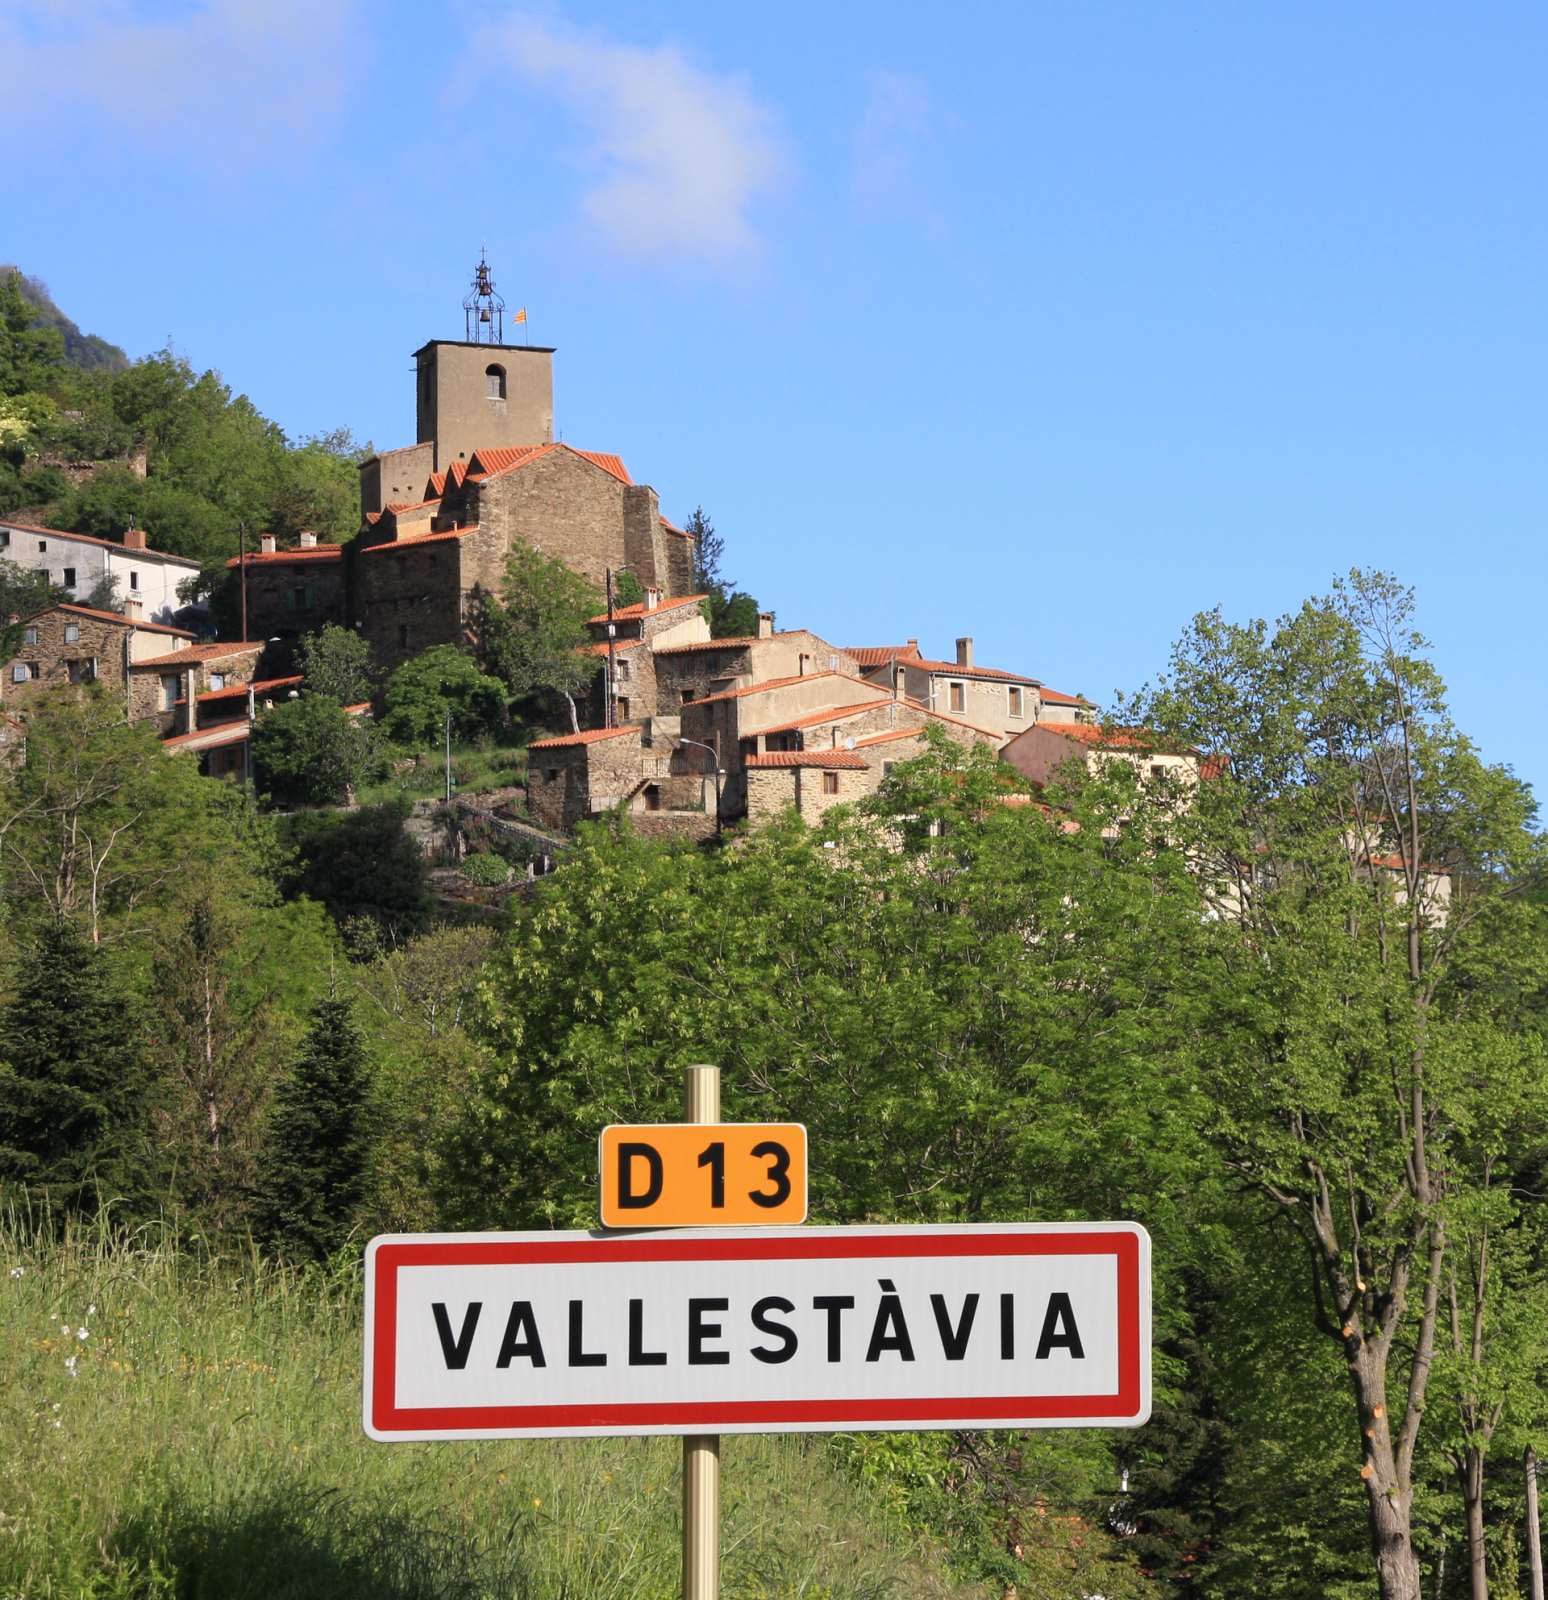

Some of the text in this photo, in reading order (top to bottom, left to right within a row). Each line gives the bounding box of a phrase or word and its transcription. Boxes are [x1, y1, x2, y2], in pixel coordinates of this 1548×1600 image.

[618, 1141, 791, 1209] D 13
[431, 1278, 1085, 1370] VALLESTÀVIA
